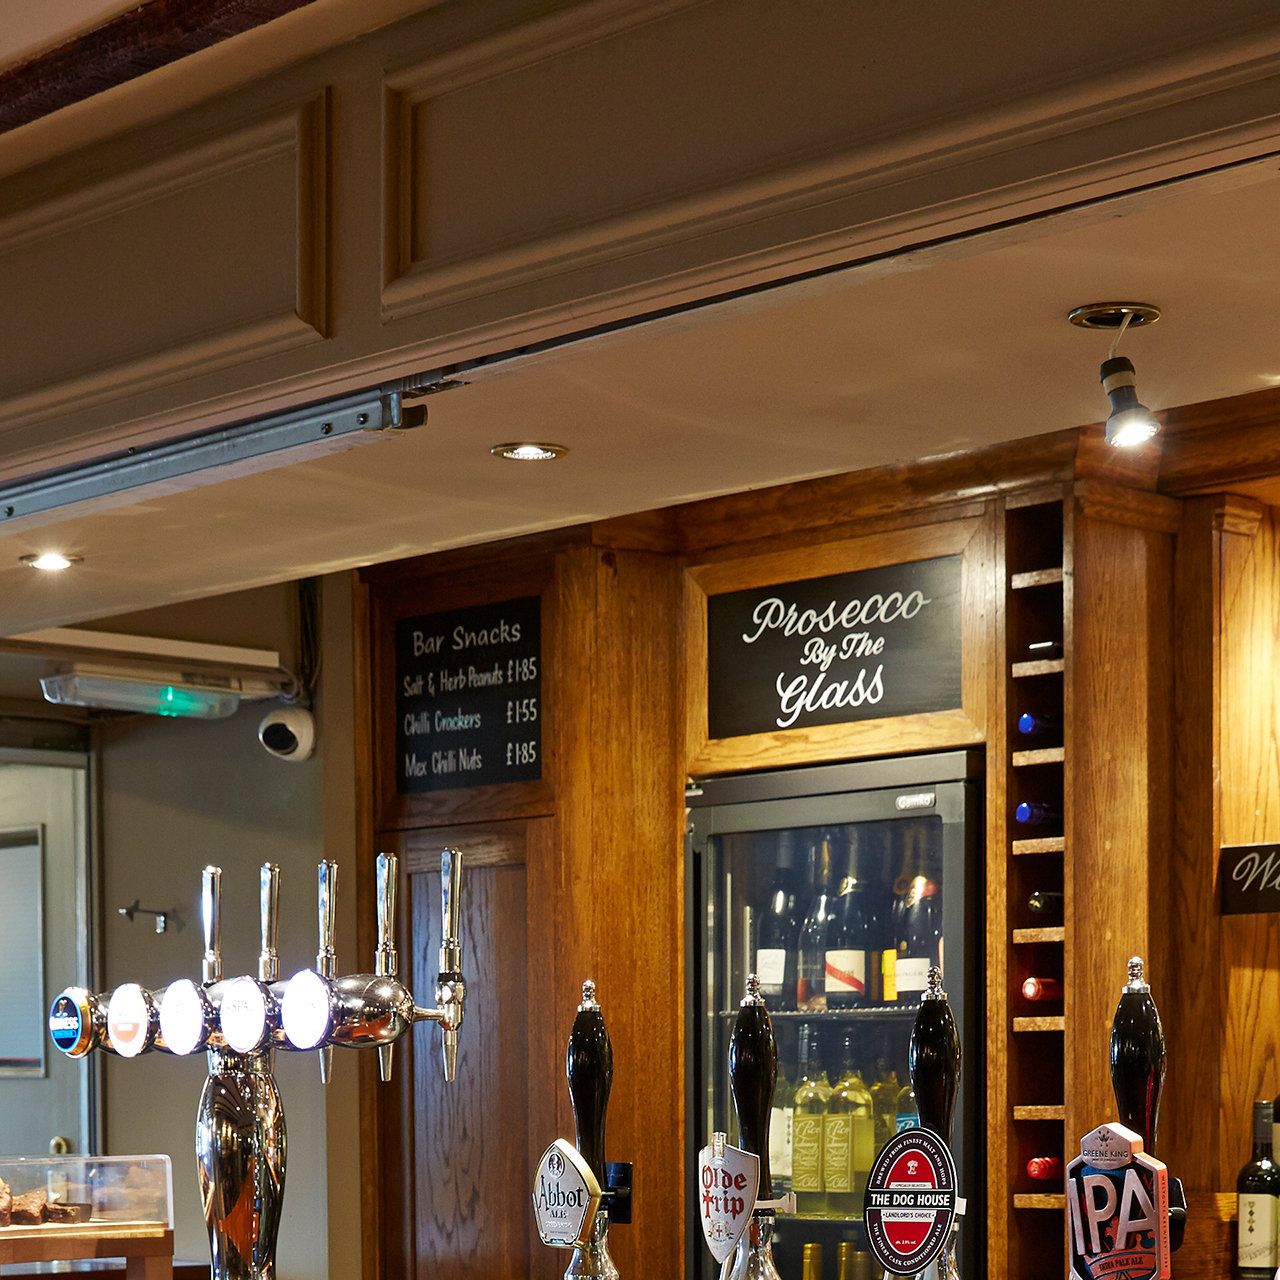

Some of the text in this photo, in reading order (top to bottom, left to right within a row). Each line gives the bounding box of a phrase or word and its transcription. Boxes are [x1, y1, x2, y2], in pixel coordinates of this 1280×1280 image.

[742, 590, 932, 643] Prosecco
[413, 619, 521, 657] Bar Snacks
[799, 631, 885, 671] By The
[403, 675, 425, 697] Salt
[428, 672, 435, 697] &
[440, 669, 467, 692] Herb
[468, 662, 504, 688] Peanuts
[776, 664, 884, 728] Glass
[404, 711, 430, 736] Chilli
[434, 707, 482, 732] Crackers
[405, 753, 428, 778] Mex
[431, 748, 457, 775] Chilli
[458, 747, 482, 772] Nuts
[876, 1159, 890, 1185] BREWED
[889, 1143, 903, 1159] FROM
[903, 1138, 923, 1146] FINEST
[923, 1140, 936, 1154] MALT
[934, 1152, 943, 1168] AND
[1110, 1150, 1129, 1158] KING
[538, 1174, 584, 1211] Abbot
[702, 1165, 747, 1190] Olde
[549, 1210, 568, 1218] ALE
[871, 1194, 950, 1206] THE DOG HOUSE
[1069, 1168, 1157, 1256] IPA
[877, 1236, 890, 1257] FINEST
[888, 1255, 903, 1266] CASK
[903, 1237, 938, 1267] CONDITIONED
[934, 1223, 943, 1238] ALE
[1099, 1256, 1144, 1271] INDIA PALE ALE
